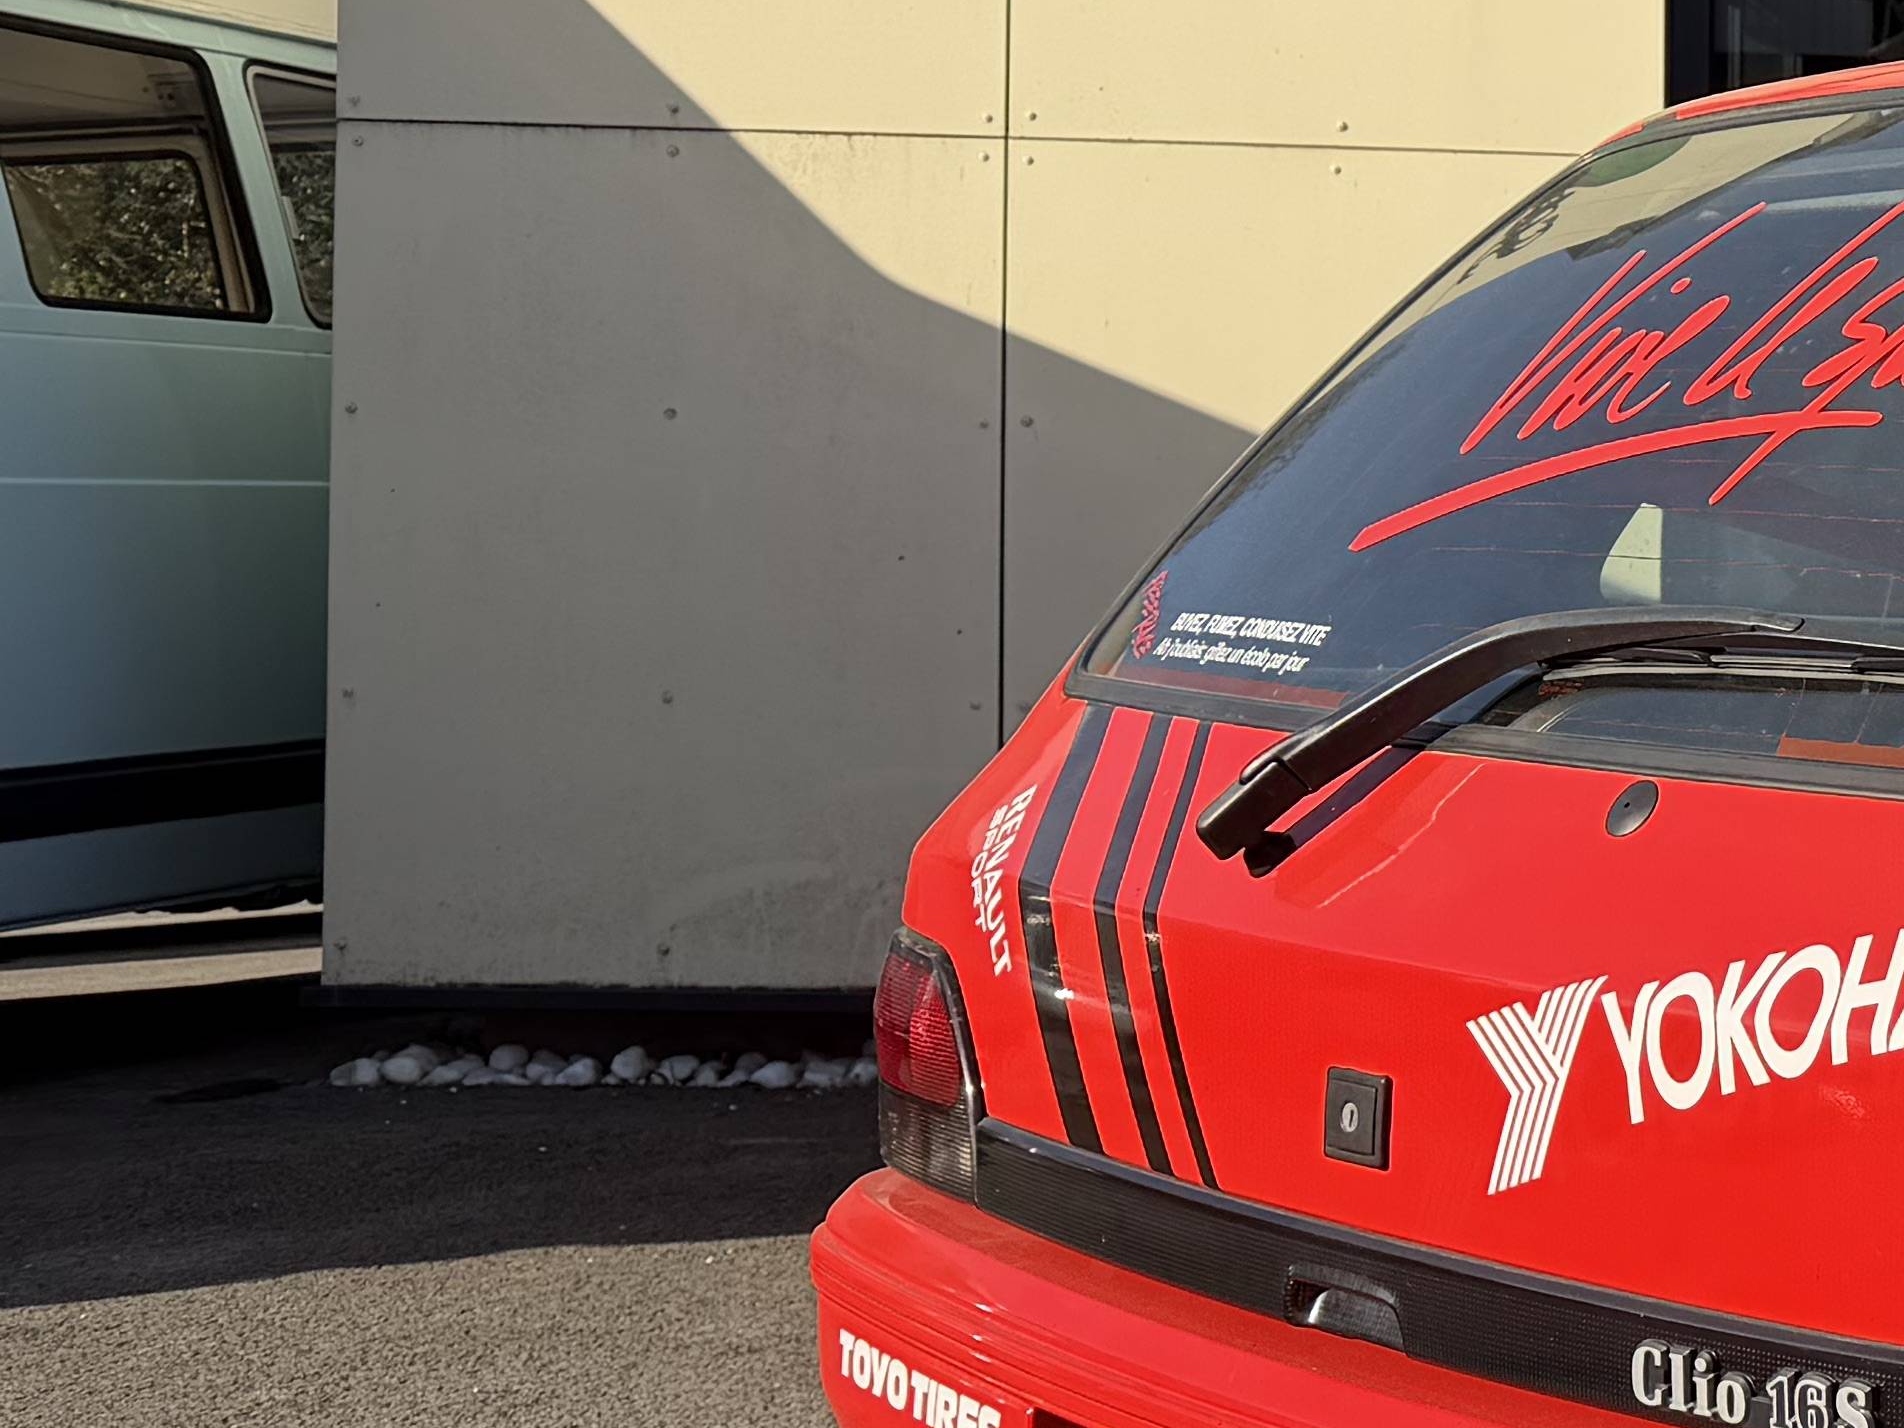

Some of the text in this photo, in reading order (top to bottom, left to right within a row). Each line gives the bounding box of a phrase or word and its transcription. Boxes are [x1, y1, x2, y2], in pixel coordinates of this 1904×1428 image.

[1461, 201, 1766, 455] Vive
[1240, 617, 1302, 644] CONDUISEZ
[1298, 624, 1332, 647] VITE
[1278, 650, 1311, 676] jour
[971, 804, 1007, 933] SPORT
[983, 783, 1038, 977] RENAULT
[838, 1329, 911, 1411] TOYO
[1630, 1339, 1753, 1426] Clio
